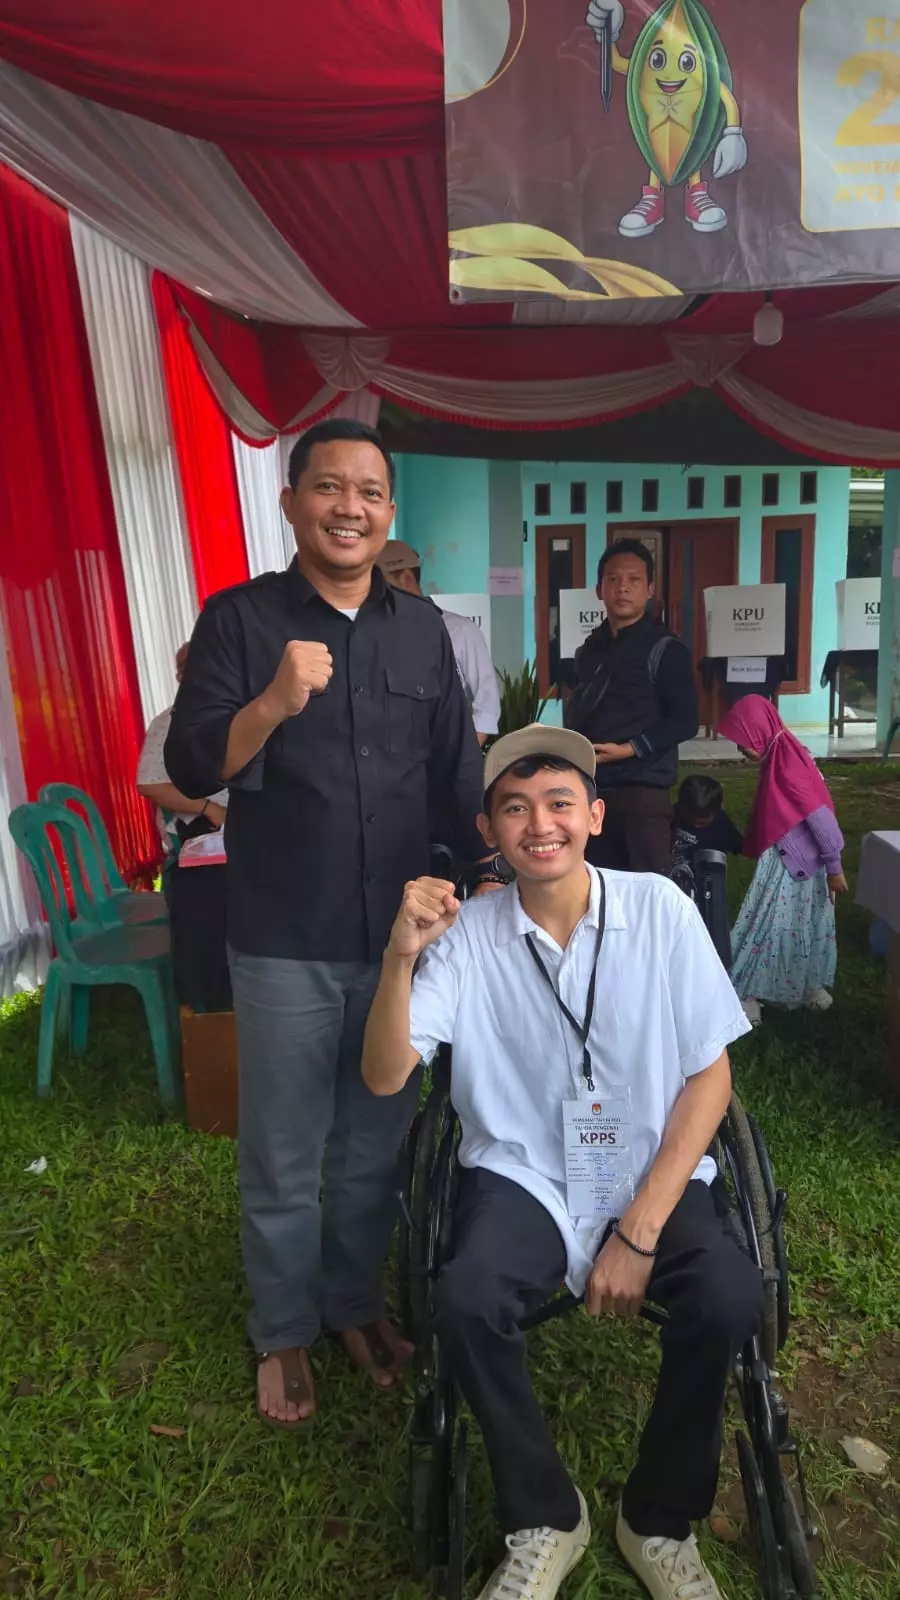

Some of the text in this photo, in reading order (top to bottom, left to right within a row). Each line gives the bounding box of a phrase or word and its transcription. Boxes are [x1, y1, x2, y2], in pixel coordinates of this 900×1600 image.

[834, 52, 900, 147] 2
[833, 183, 885, 203] AYO
[732, 607, 765, 621] KPU
[580, 1132, 616, 1144] KPPS
